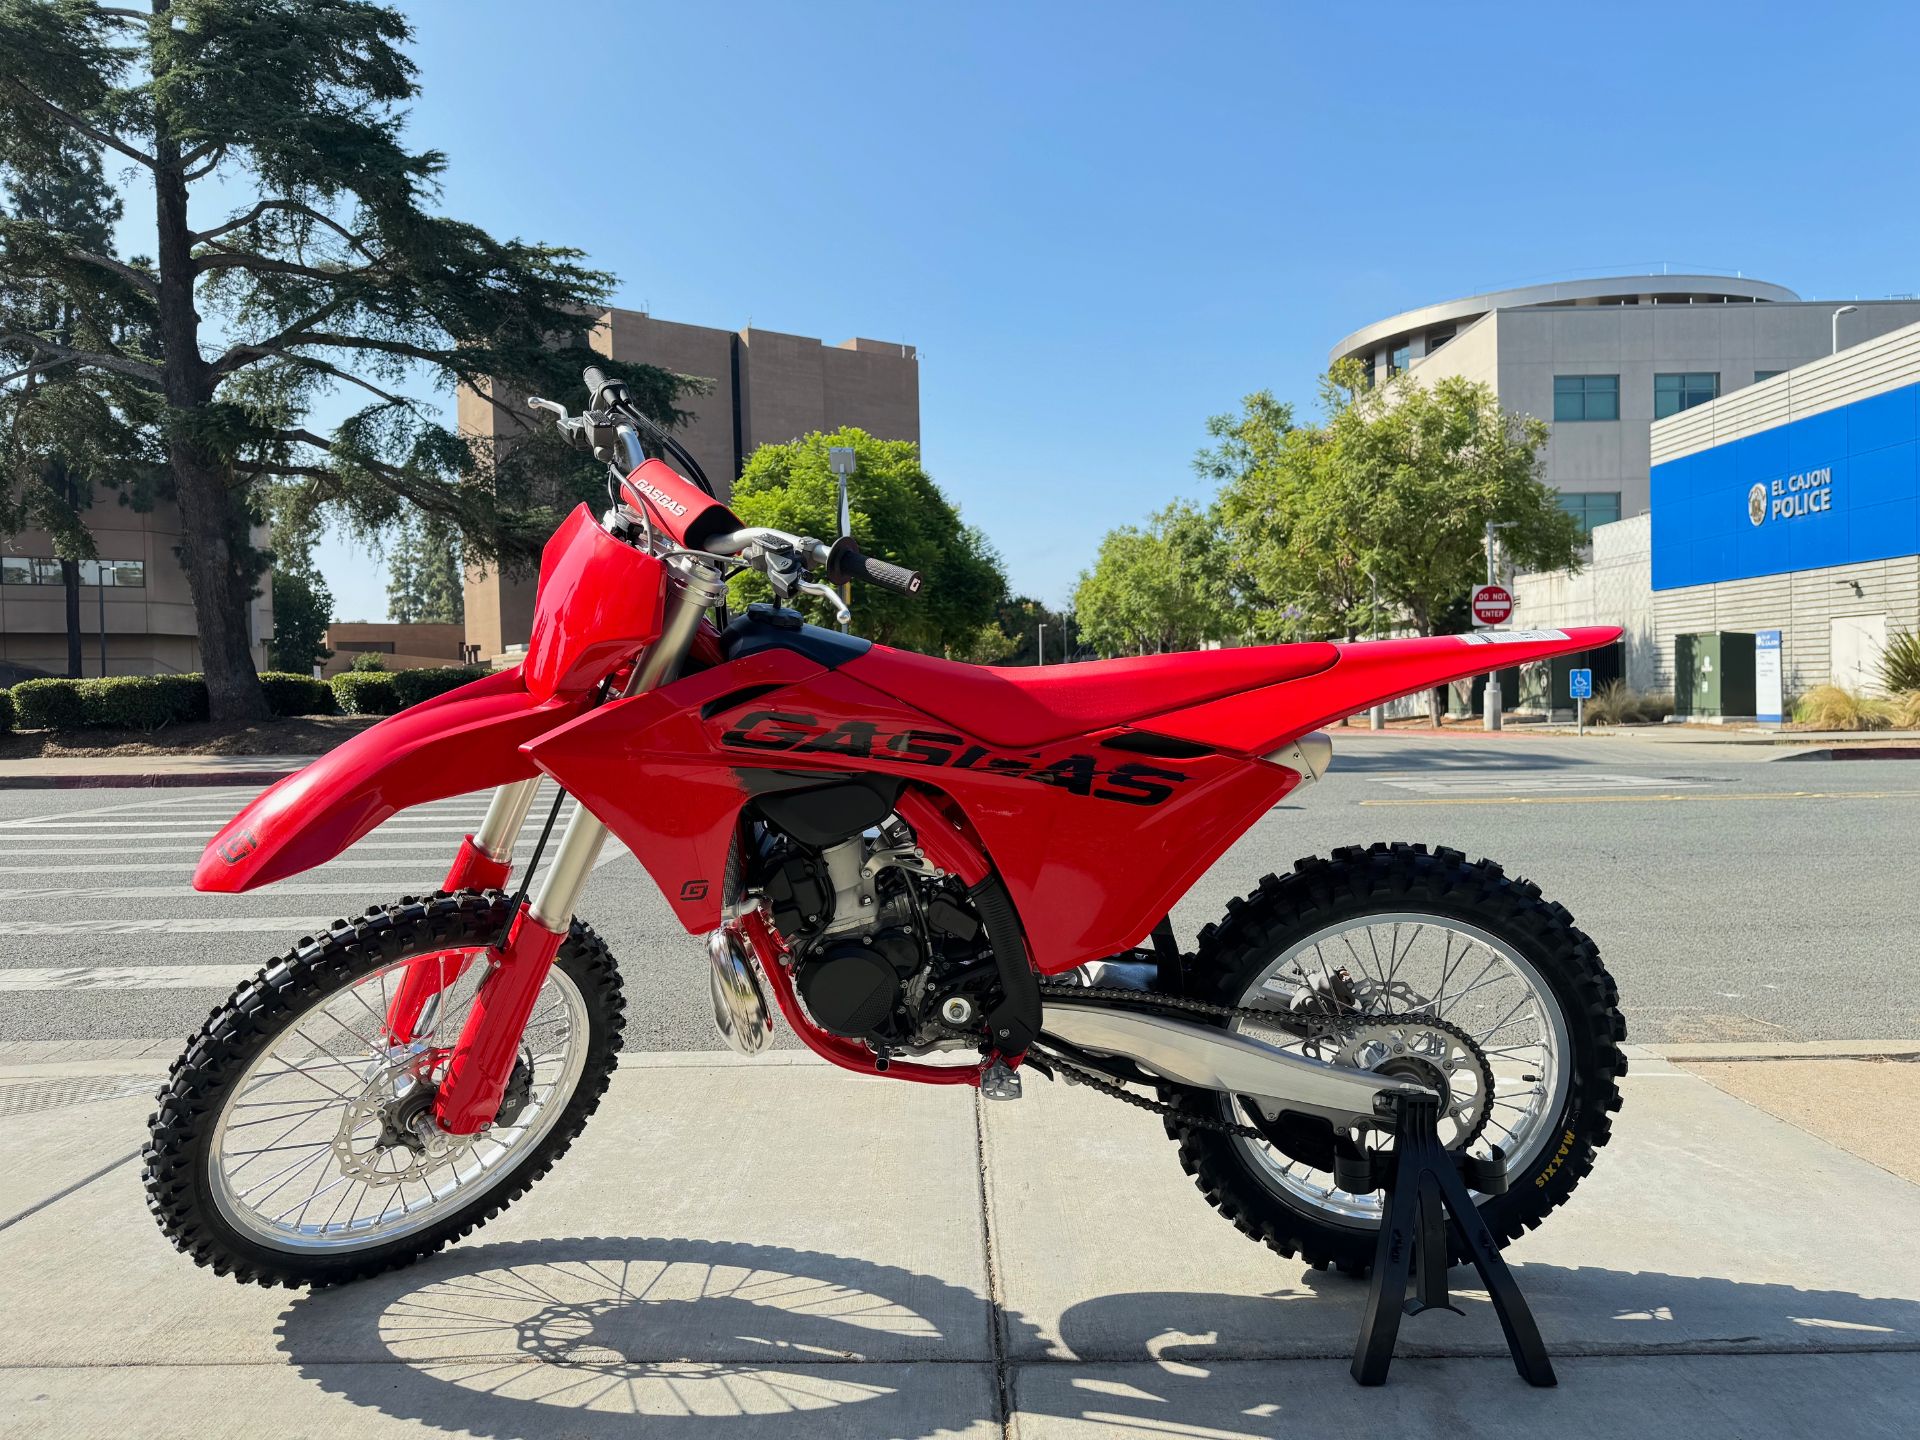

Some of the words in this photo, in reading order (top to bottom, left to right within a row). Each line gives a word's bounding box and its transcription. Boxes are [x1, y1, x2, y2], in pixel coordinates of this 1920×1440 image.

[1772, 480, 1787, 496] EL
[1788, 467, 1832, 492] CAJON
[633, 479, 689, 517] GASGAS
[1772, 487, 1832, 520] POLICE
[1478, 592, 1489, 601] DO
[1492, 592, 1507, 601] NOT
[1480, 609, 1504, 618] ENTER
[1535, 1129, 1577, 1188] MAXXIS
